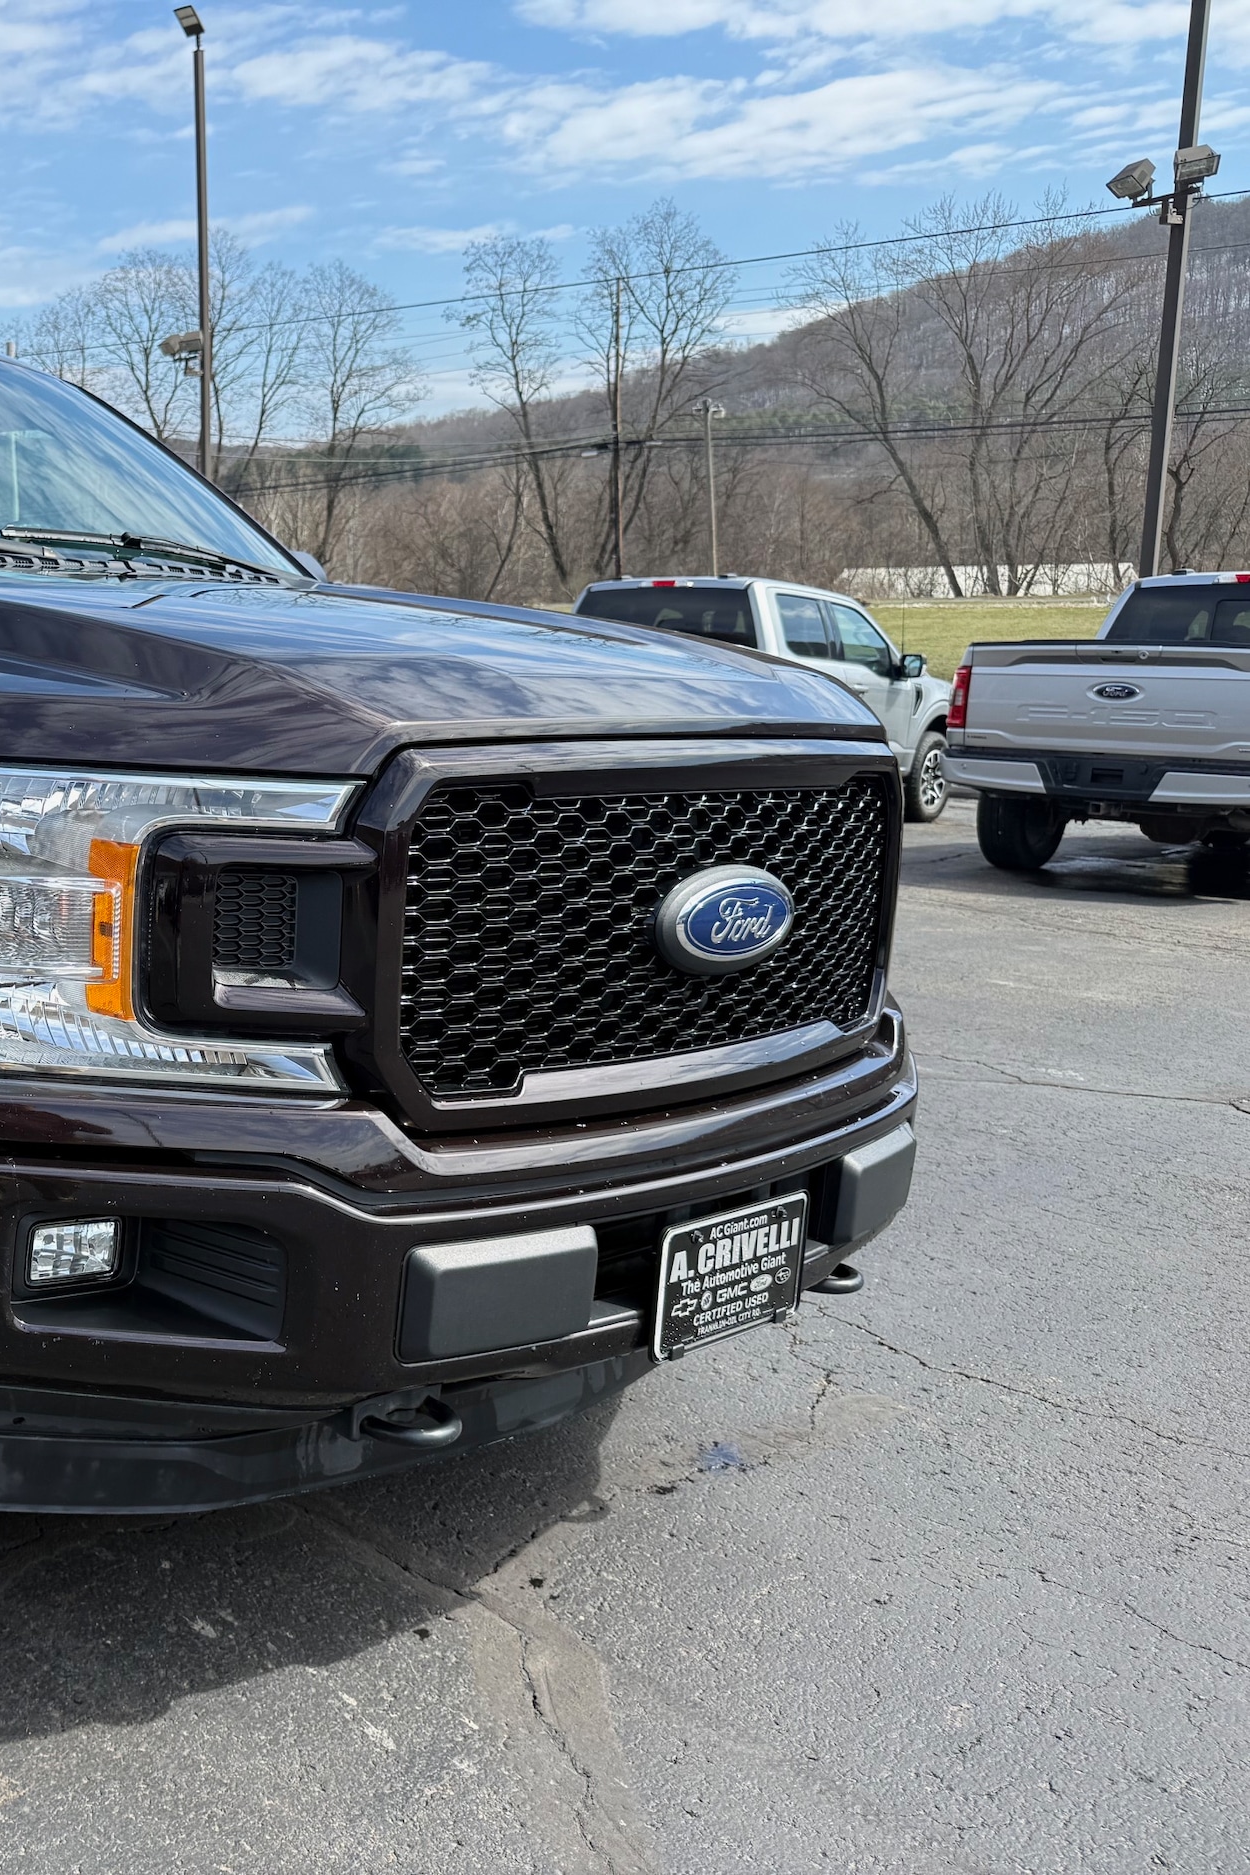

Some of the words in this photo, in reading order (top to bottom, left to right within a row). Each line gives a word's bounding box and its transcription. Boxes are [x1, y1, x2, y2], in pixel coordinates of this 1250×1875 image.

[1102, 686, 1129, 698] Ford
[710, 897, 774, 944] Ford
[669, 1250, 694, 1283] A.
[697, 1217, 800, 1275] CRIVELLI
[681, 1278, 700, 1296] The
[702, 1263, 759, 1290] Automotive
[760, 1252, 787, 1271] Giant
[716, 1281, 748, 1302] GMC
[693, 1301, 743, 1326] CERTIFIED
[745, 1292, 768, 1308] USED
[738, 1311, 750, 1322] CITY
